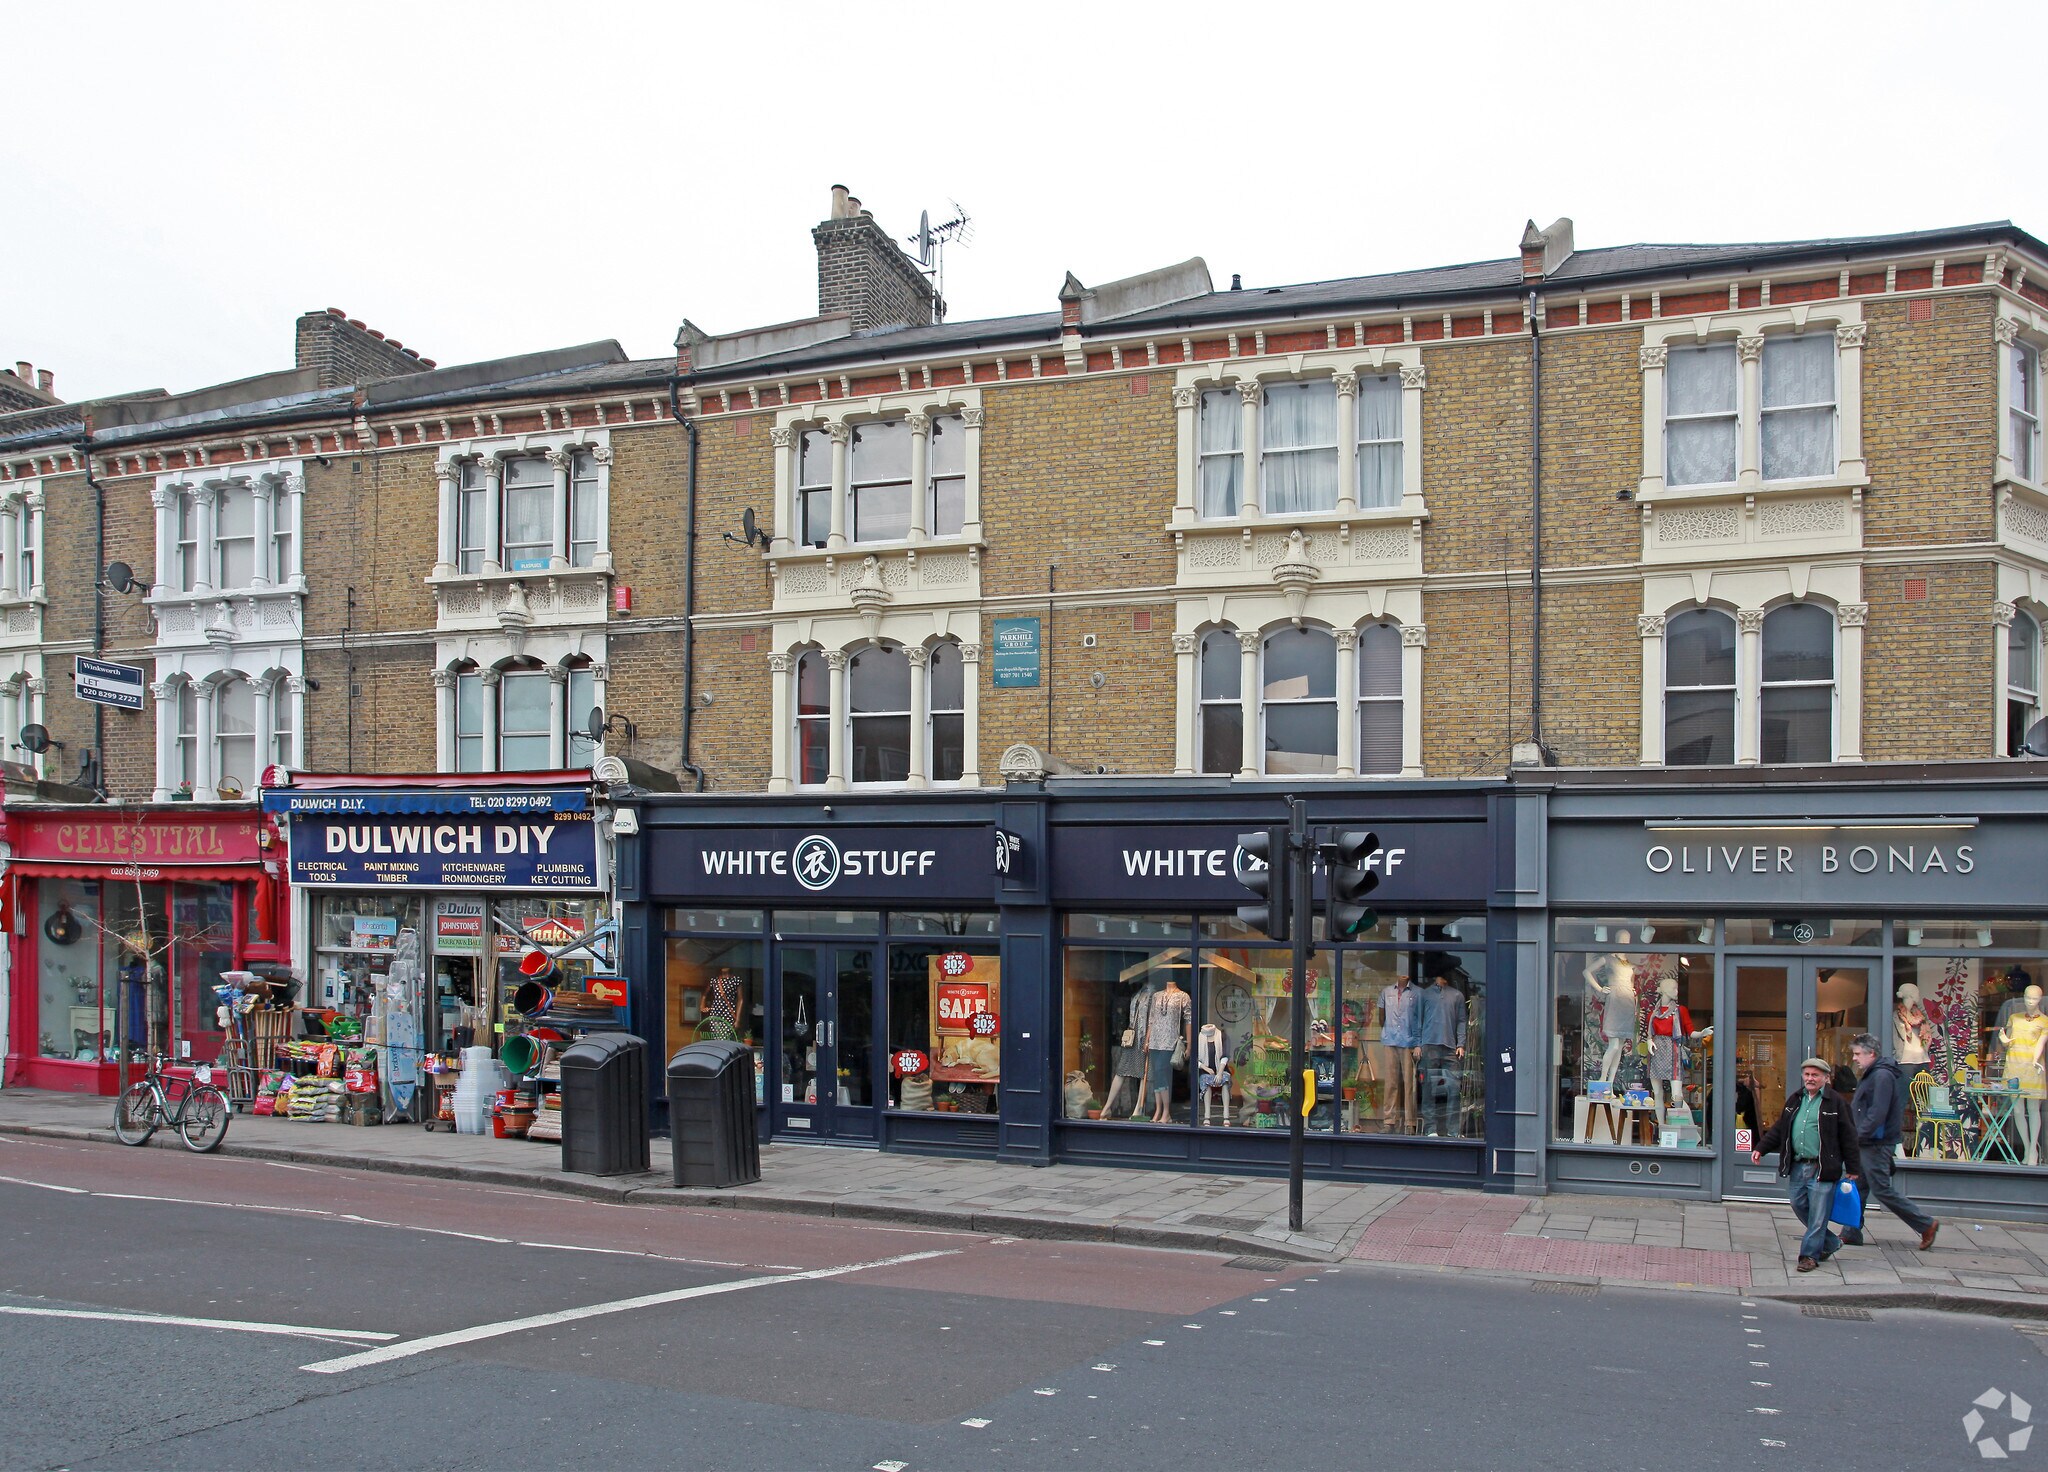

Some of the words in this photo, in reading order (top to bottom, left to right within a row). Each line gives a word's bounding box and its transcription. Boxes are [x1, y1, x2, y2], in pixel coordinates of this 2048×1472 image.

[1000, 633, 1034, 641] PARKHILL
[83, 663, 121, 675] Winkworth
[83, 677, 99, 687] LET
[83, 688, 97, 696] 020
[98, 691, 117, 699] 8299
[118, 694, 137, 703] 2722
[291, 799, 336, 809] DULWICH
[341, 799, 366, 809] D.I.Y.
[470, 797, 486, 808] TEL:
[487, 797, 504, 807] 020
[506, 796, 528, 807] 8299
[529, 796, 551, 807] 0492
[554, 812, 572, 821] 8299
[573, 812, 591, 821] 0492
[33, 823, 44, 833] 34
[240, 825, 251, 835] 34
[326, 825, 482, 855] DULWICH
[495, 825, 555, 854] DIY
[701, 850, 787, 875] WHITE
[843, 850, 936, 876] STUFF
[1122, 849, 1227, 876] WHITE
[1646, 845, 1794, 873] OLIVER
[1821, 845, 1975, 874] BONAS
[111, 867, 124, 875] 020
[298, 862, 348, 871] ELECTRICAL
[364, 862, 388, 871] PAINT
[389, 862, 420, 872] MIXING
[442, 863, 506, 872] KITCHENWARE
[537, 864, 585, 873] PLUMBING
[309, 873, 337, 882] TOOLS
[376, 873, 408, 882] TIMBER
[441, 875, 507, 884] IRONMONGERY
[531, 876, 549, 884] KEY
[551, 876, 591, 885] CUTTING
[447, 902, 482, 915] Dulux
[440, 921, 479, 931] JOHNSTONE'S
[1797, 928, 1811, 939] 26
[943, 959, 966, 970] 30%
[939, 997, 986, 1019] SALE
[973, 1019, 996, 1029] 30%
[898, 1057, 921, 1068] 30%
